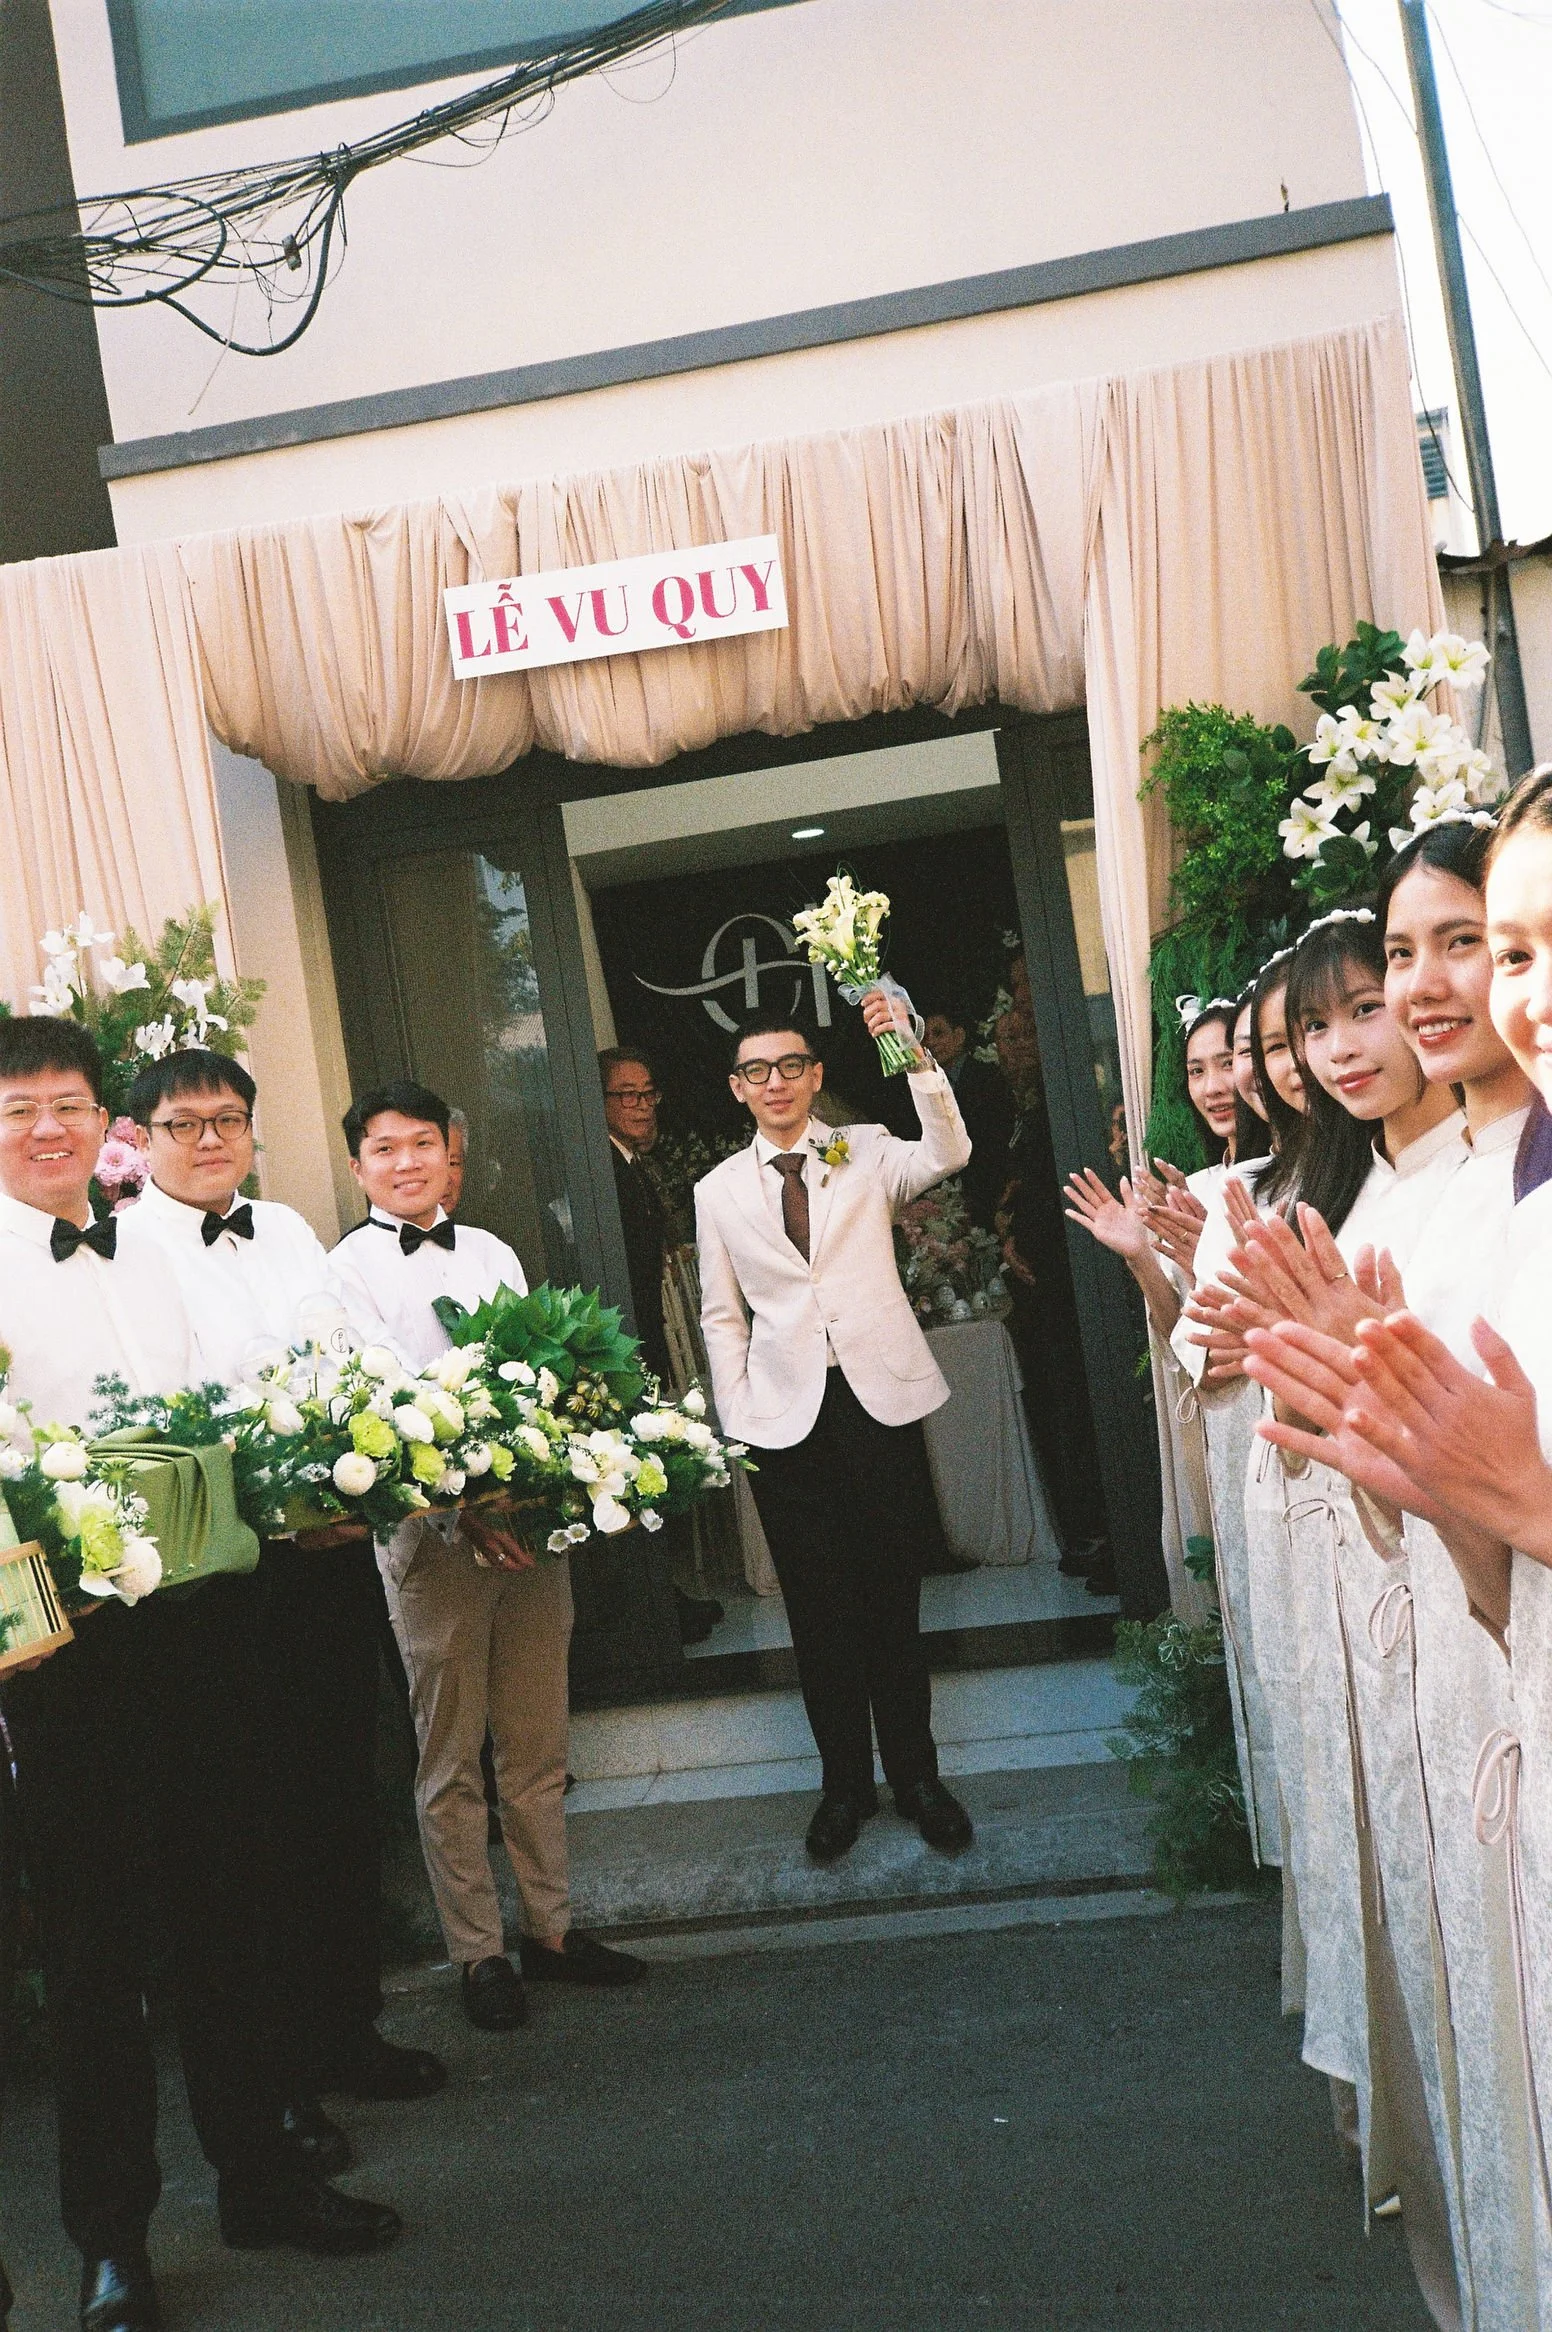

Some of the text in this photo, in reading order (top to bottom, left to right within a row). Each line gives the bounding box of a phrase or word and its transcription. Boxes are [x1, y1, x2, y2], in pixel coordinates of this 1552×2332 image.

[453, 560, 776, 660] LỄ VU QUY
